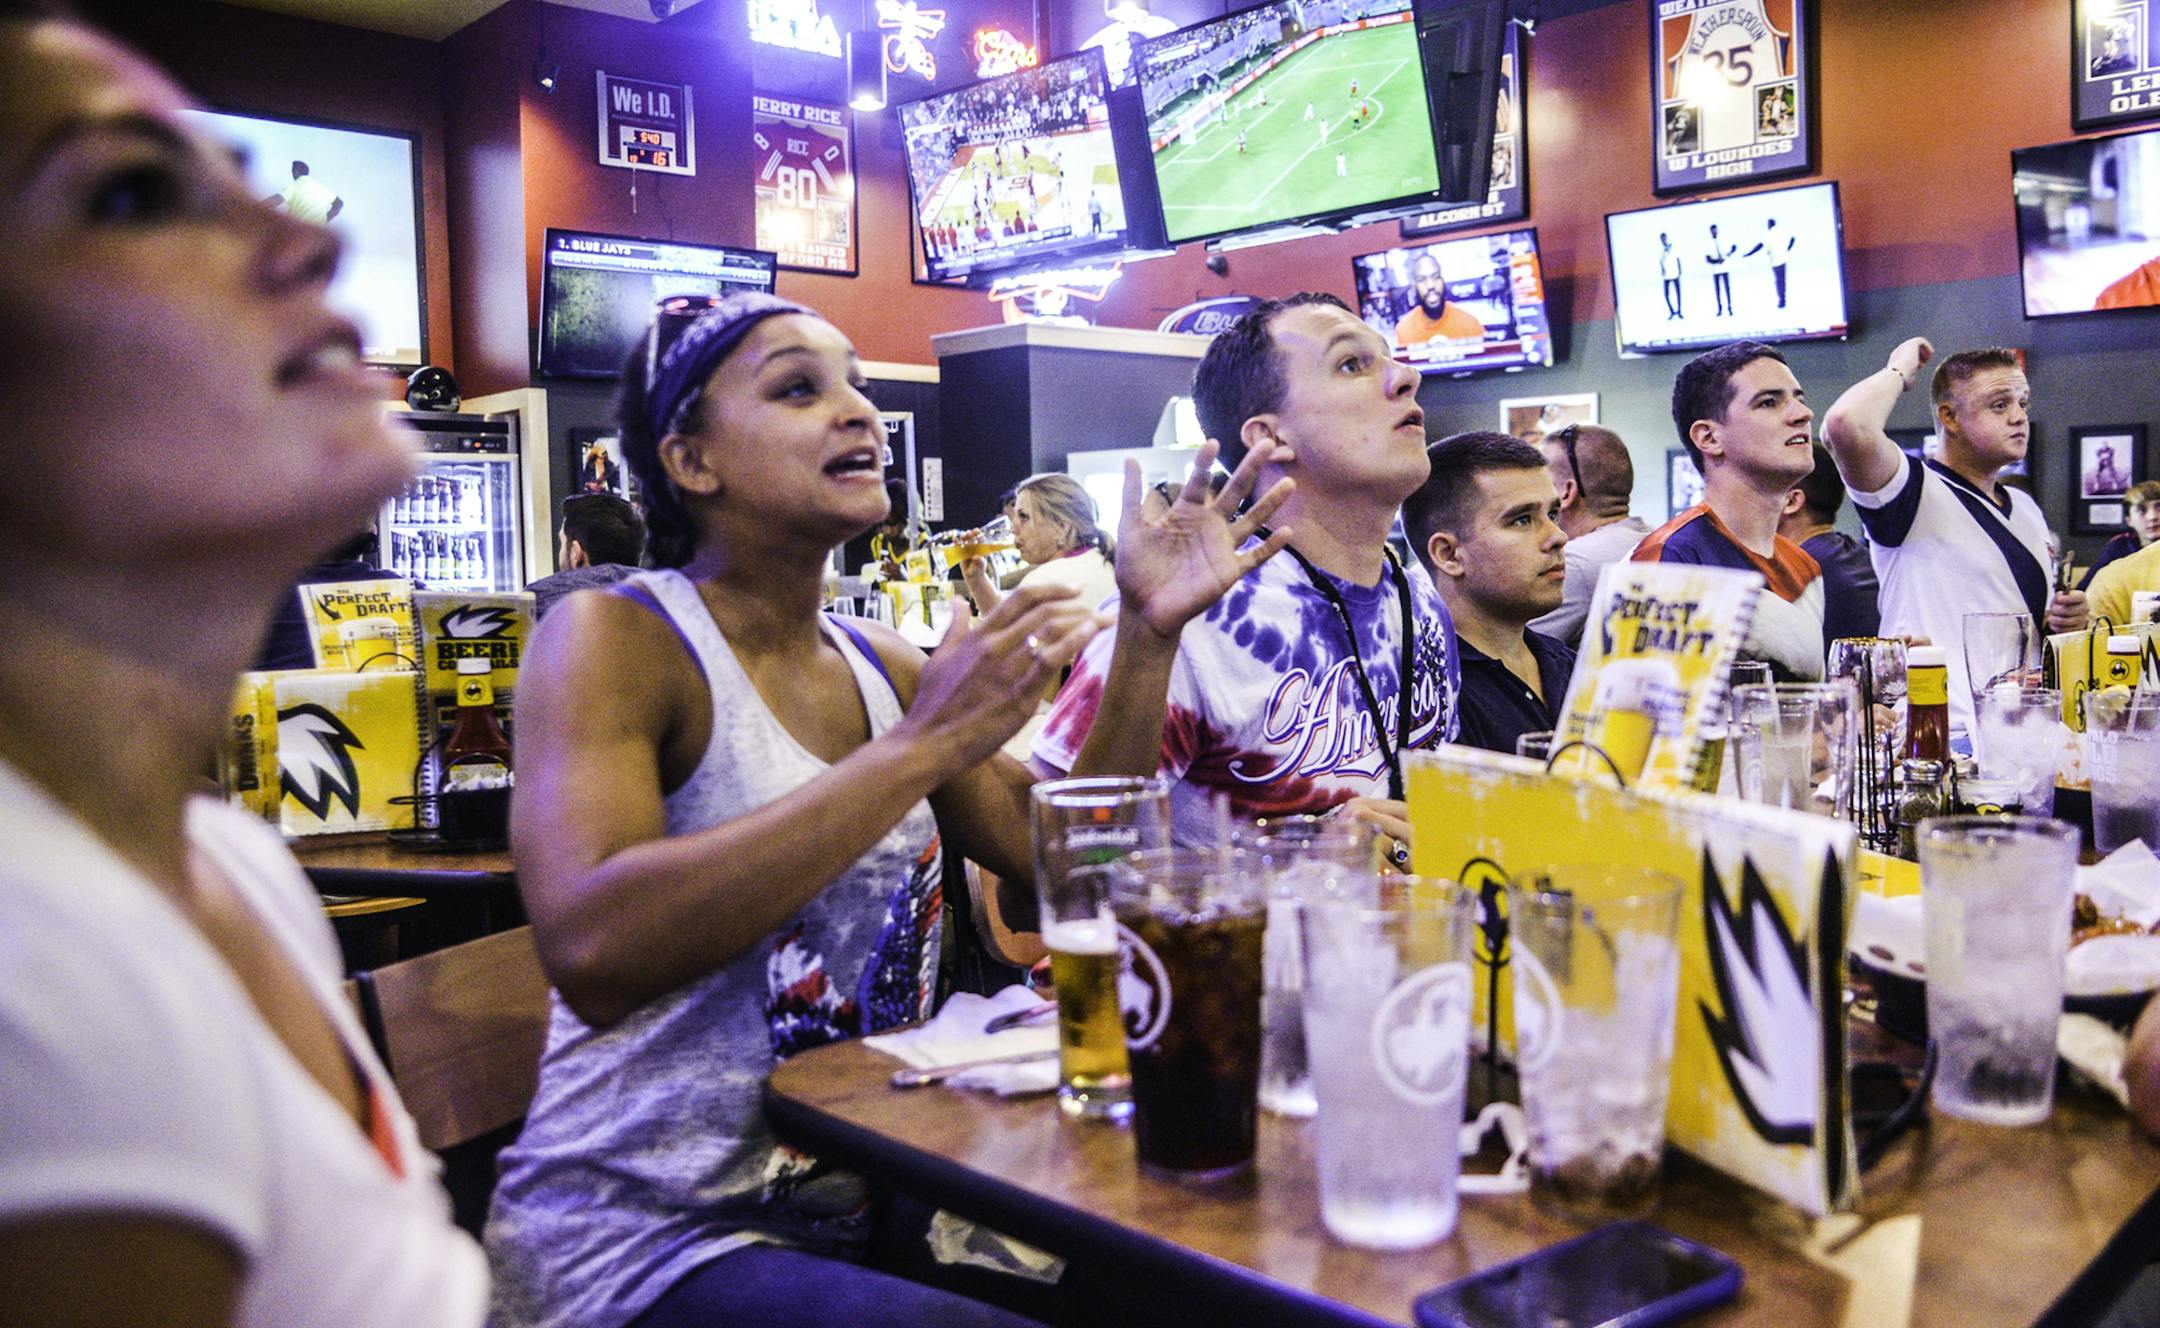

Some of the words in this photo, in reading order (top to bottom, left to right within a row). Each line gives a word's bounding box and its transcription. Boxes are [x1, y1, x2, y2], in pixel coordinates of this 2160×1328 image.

[612, 85, 642, 114] We
[647, 91, 676, 120] I.D.
[753, 96, 802, 117] JERRY
[804, 105, 841, 125] RICE
[786, 138, 809, 156] RICE
[1667, 156, 1689, 172] W
[1691, 140, 1793, 168] LOWNDES
[1704, 160, 1754, 180] HIGH
[777, 165, 817, 210] 80
[1417, 205, 1481, 228] ALCORN
[1481, 201, 1506, 218] ST
[572, 240, 600, 254] BLUE
[601, 243, 632, 256] JAYS
[322, 592, 391, 606] PERFECT
[356, 602, 408, 616] DRAFT
